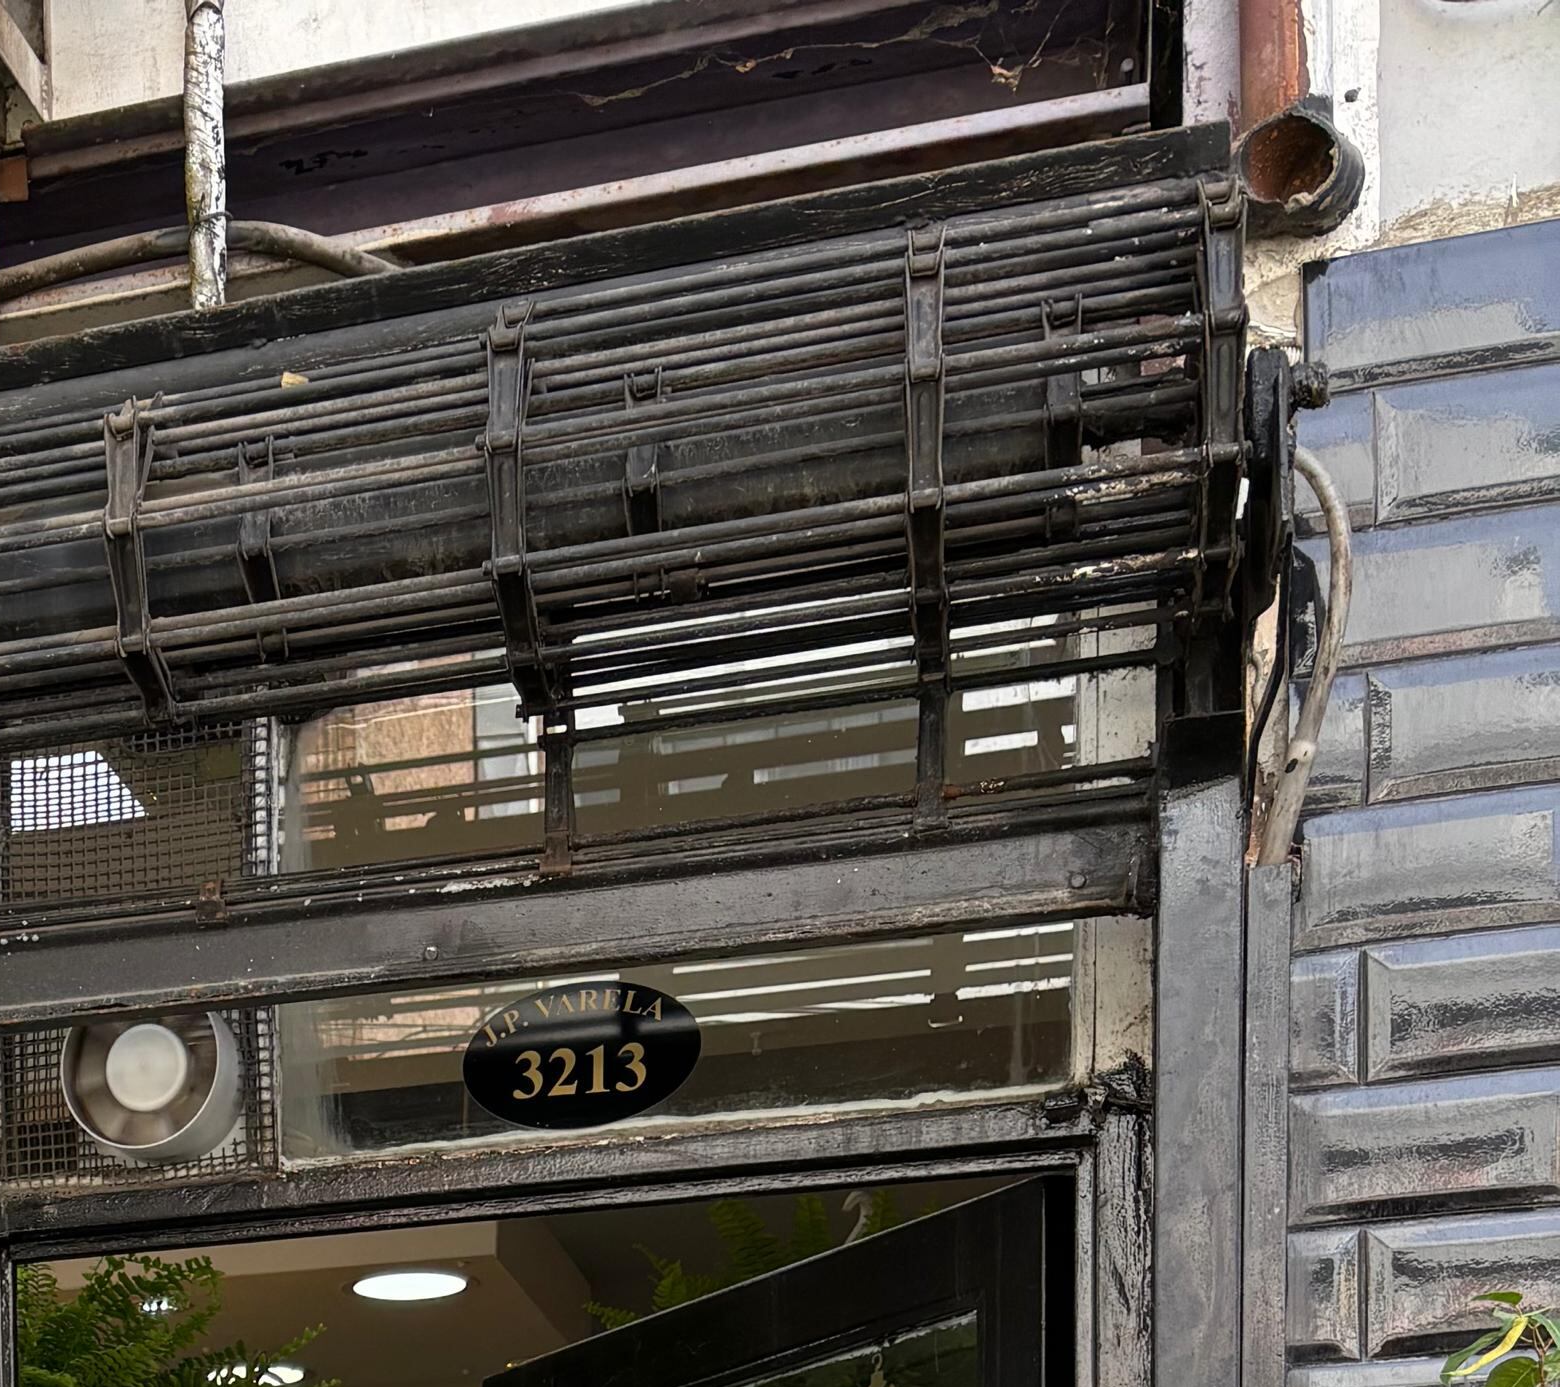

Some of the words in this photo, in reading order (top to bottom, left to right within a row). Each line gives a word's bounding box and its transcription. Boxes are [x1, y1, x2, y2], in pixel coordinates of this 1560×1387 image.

[481, 1008, 529, 1048] J.P.
[535, 988, 663, 1021] VARELA
[512, 1042, 647, 1100] 3213
